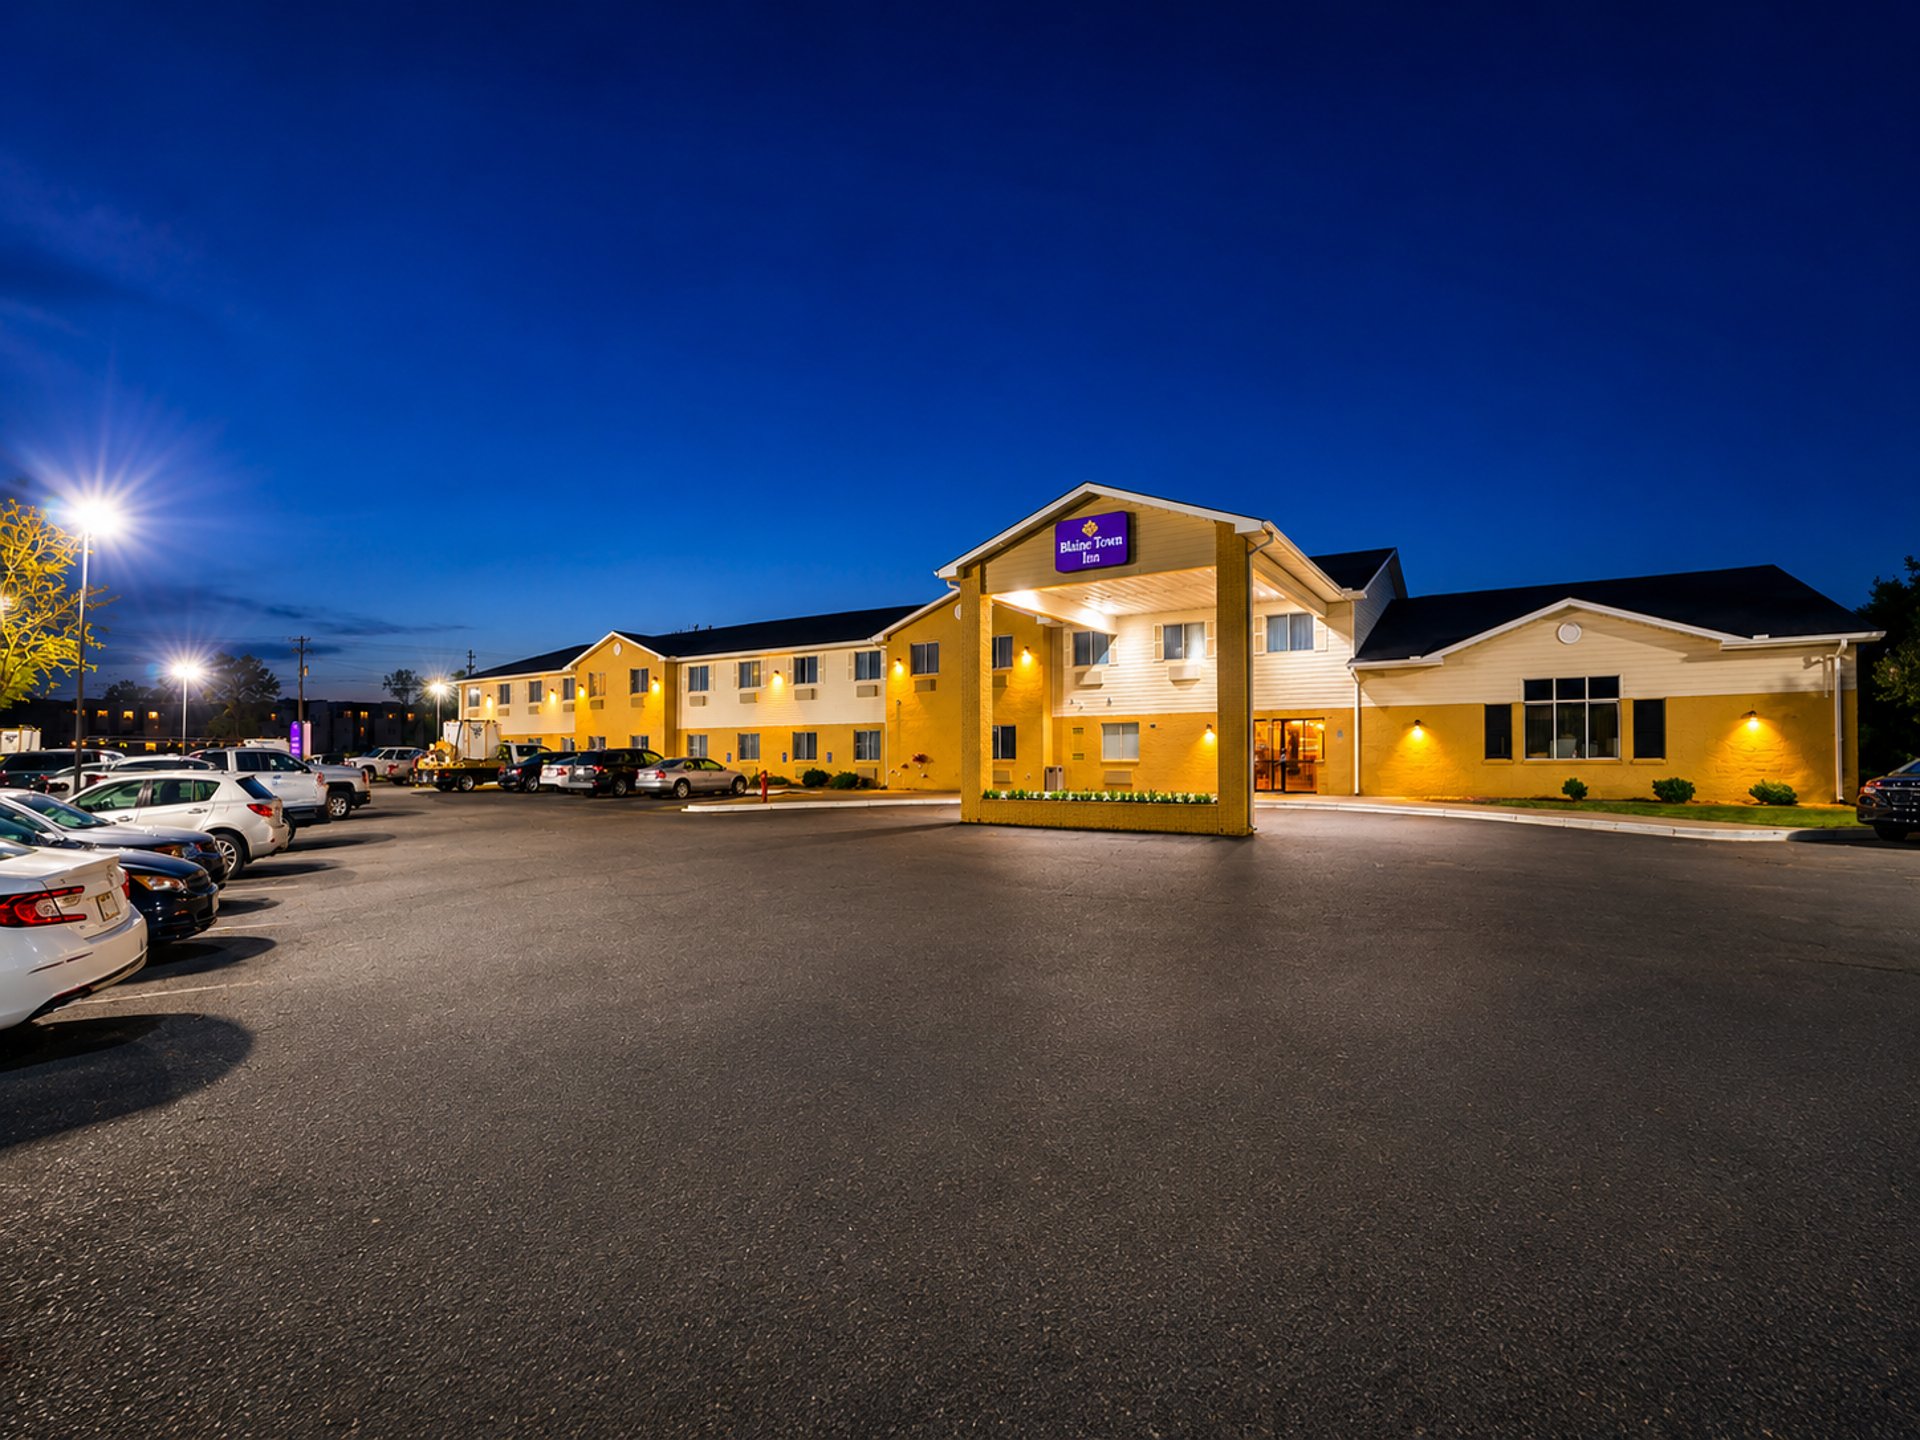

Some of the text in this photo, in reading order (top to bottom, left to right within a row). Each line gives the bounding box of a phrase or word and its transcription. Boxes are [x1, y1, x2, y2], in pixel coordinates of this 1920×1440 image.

[1060, 536, 1123, 553] Blaine Town
[1082, 551, 1100, 564] Inn
